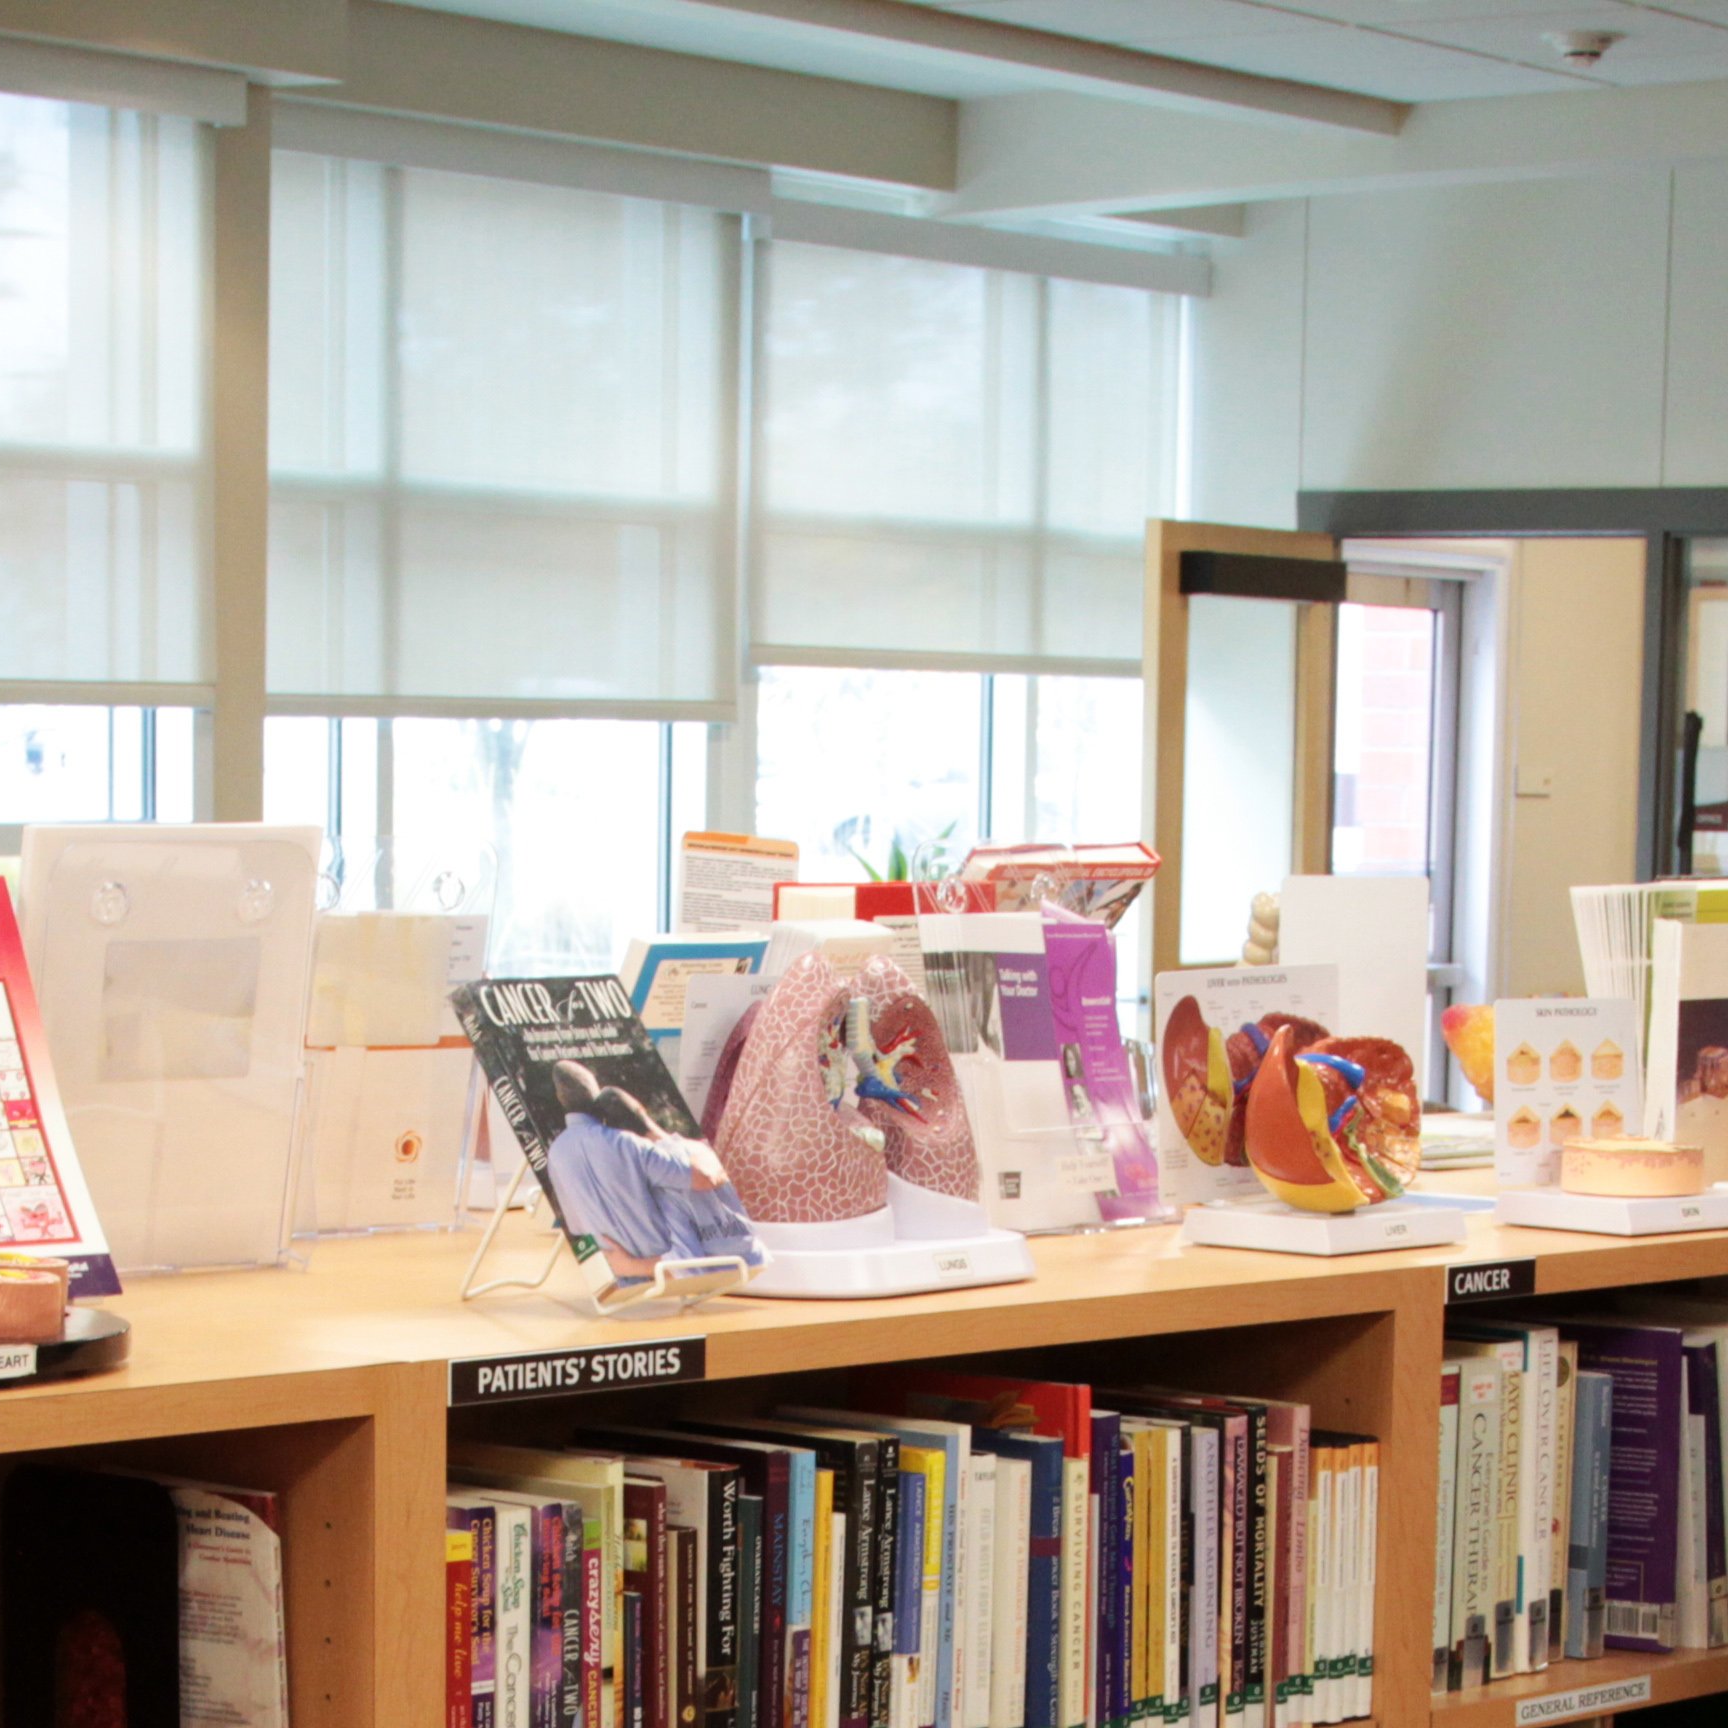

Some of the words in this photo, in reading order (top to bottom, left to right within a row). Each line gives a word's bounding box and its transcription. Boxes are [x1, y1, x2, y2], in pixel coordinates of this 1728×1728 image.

[480, 982, 560, 1027] CANCER
[575, 980, 633, 1020] TWO
[1385, 1225, 1408, 1237] LIVER
[1680, 1206, 1700, 1218] SKIN
[937, 1258, 967, 1272] LUNGS
[1454, 1268, 1510, 1295] CANCER
[478, 1355, 587, 1394] PATIENTS'
[591, 1347, 681, 1383] STORIES
[1255, 1415, 1266, 1476] SEEDS
[722, 1480, 736, 1539] Worth
[1255, 1483, 1266, 1503] OF
[1254, 1516, 1266, 1607] MORTALITY
[718, 1544, 736, 1621] Fighting
[722, 1626, 735, 1655] For
[1521, 1692, 1576, 1720] GENERAL
[1579, 1680, 1647, 1712] REFERENCE
